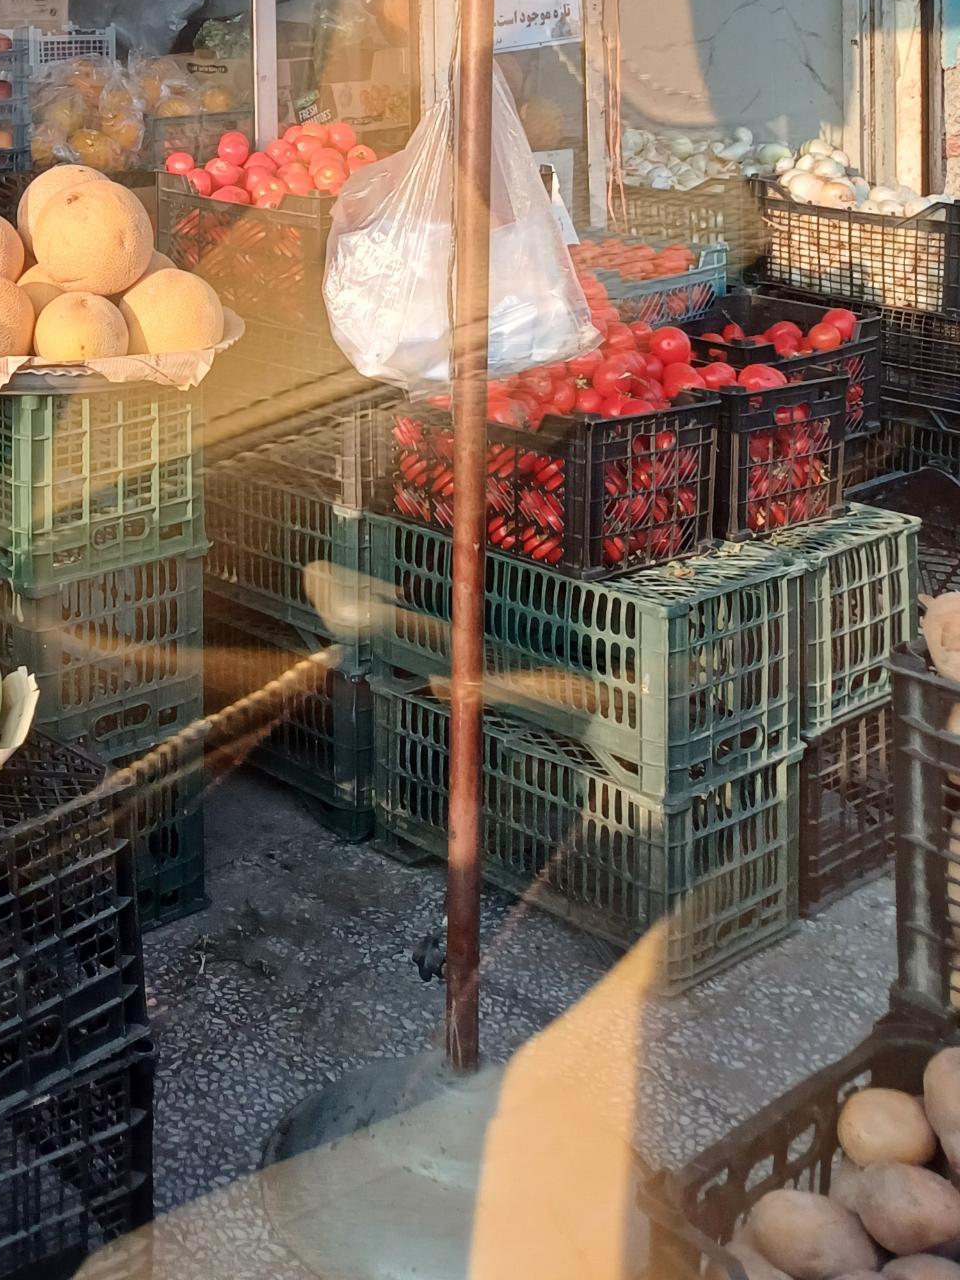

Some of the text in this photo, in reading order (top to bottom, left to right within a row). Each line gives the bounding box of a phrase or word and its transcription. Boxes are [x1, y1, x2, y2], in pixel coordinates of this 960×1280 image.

[553, 3, 571, 18] تازه
[519, 11, 551, 27] موجود
[298, 103, 319, 122] FRESH
